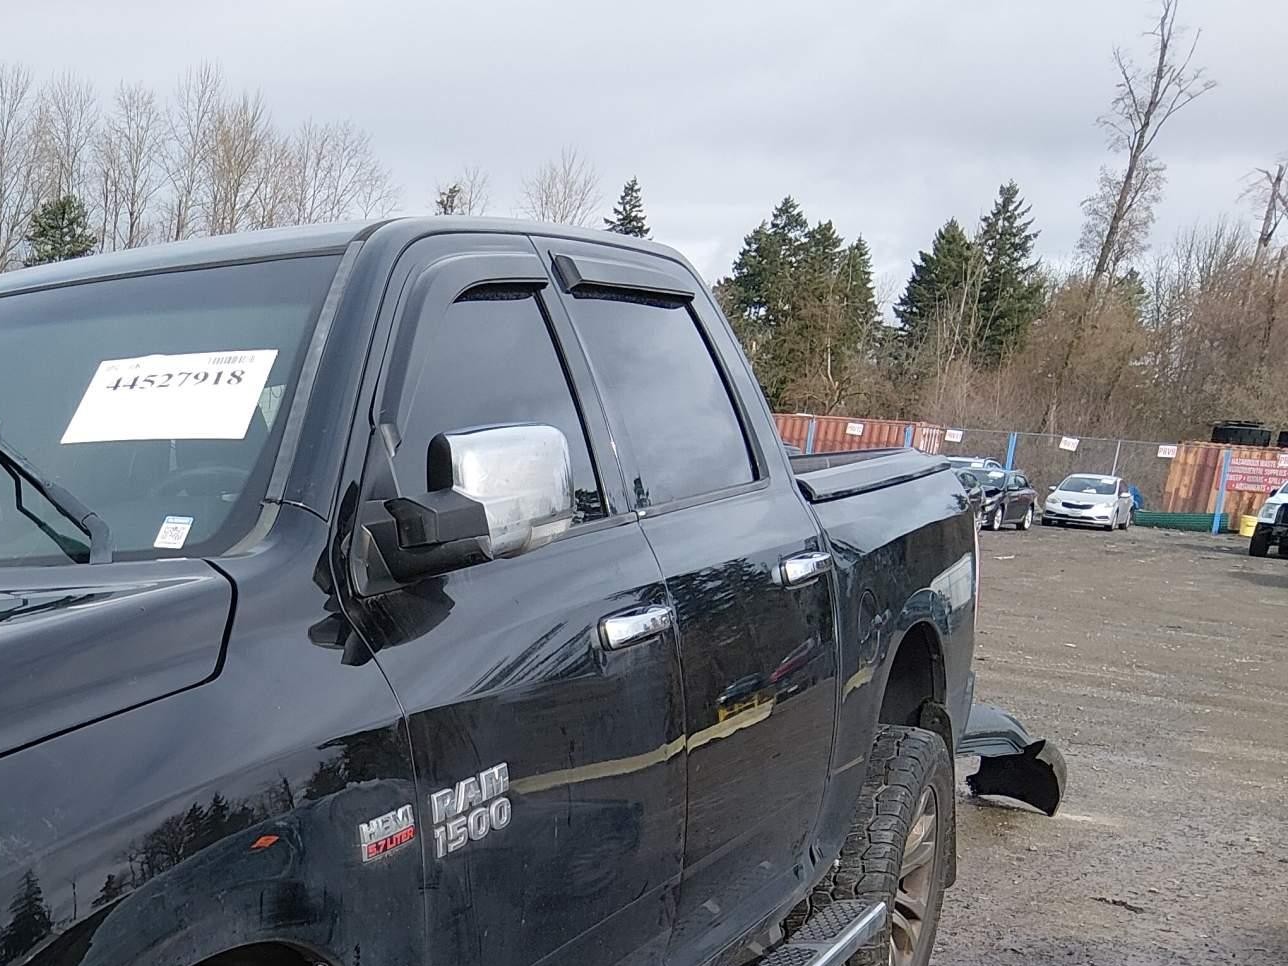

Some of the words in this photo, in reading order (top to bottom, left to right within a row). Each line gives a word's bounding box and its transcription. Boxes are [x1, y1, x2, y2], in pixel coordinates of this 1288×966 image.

[105, 369, 246, 392] 44527918
[430, 761, 510, 825] RAM
[359, 803, 415, 843] HEMI
[386, 827, 415, 850] LITER
[433, 796, 512, 859] 1500
